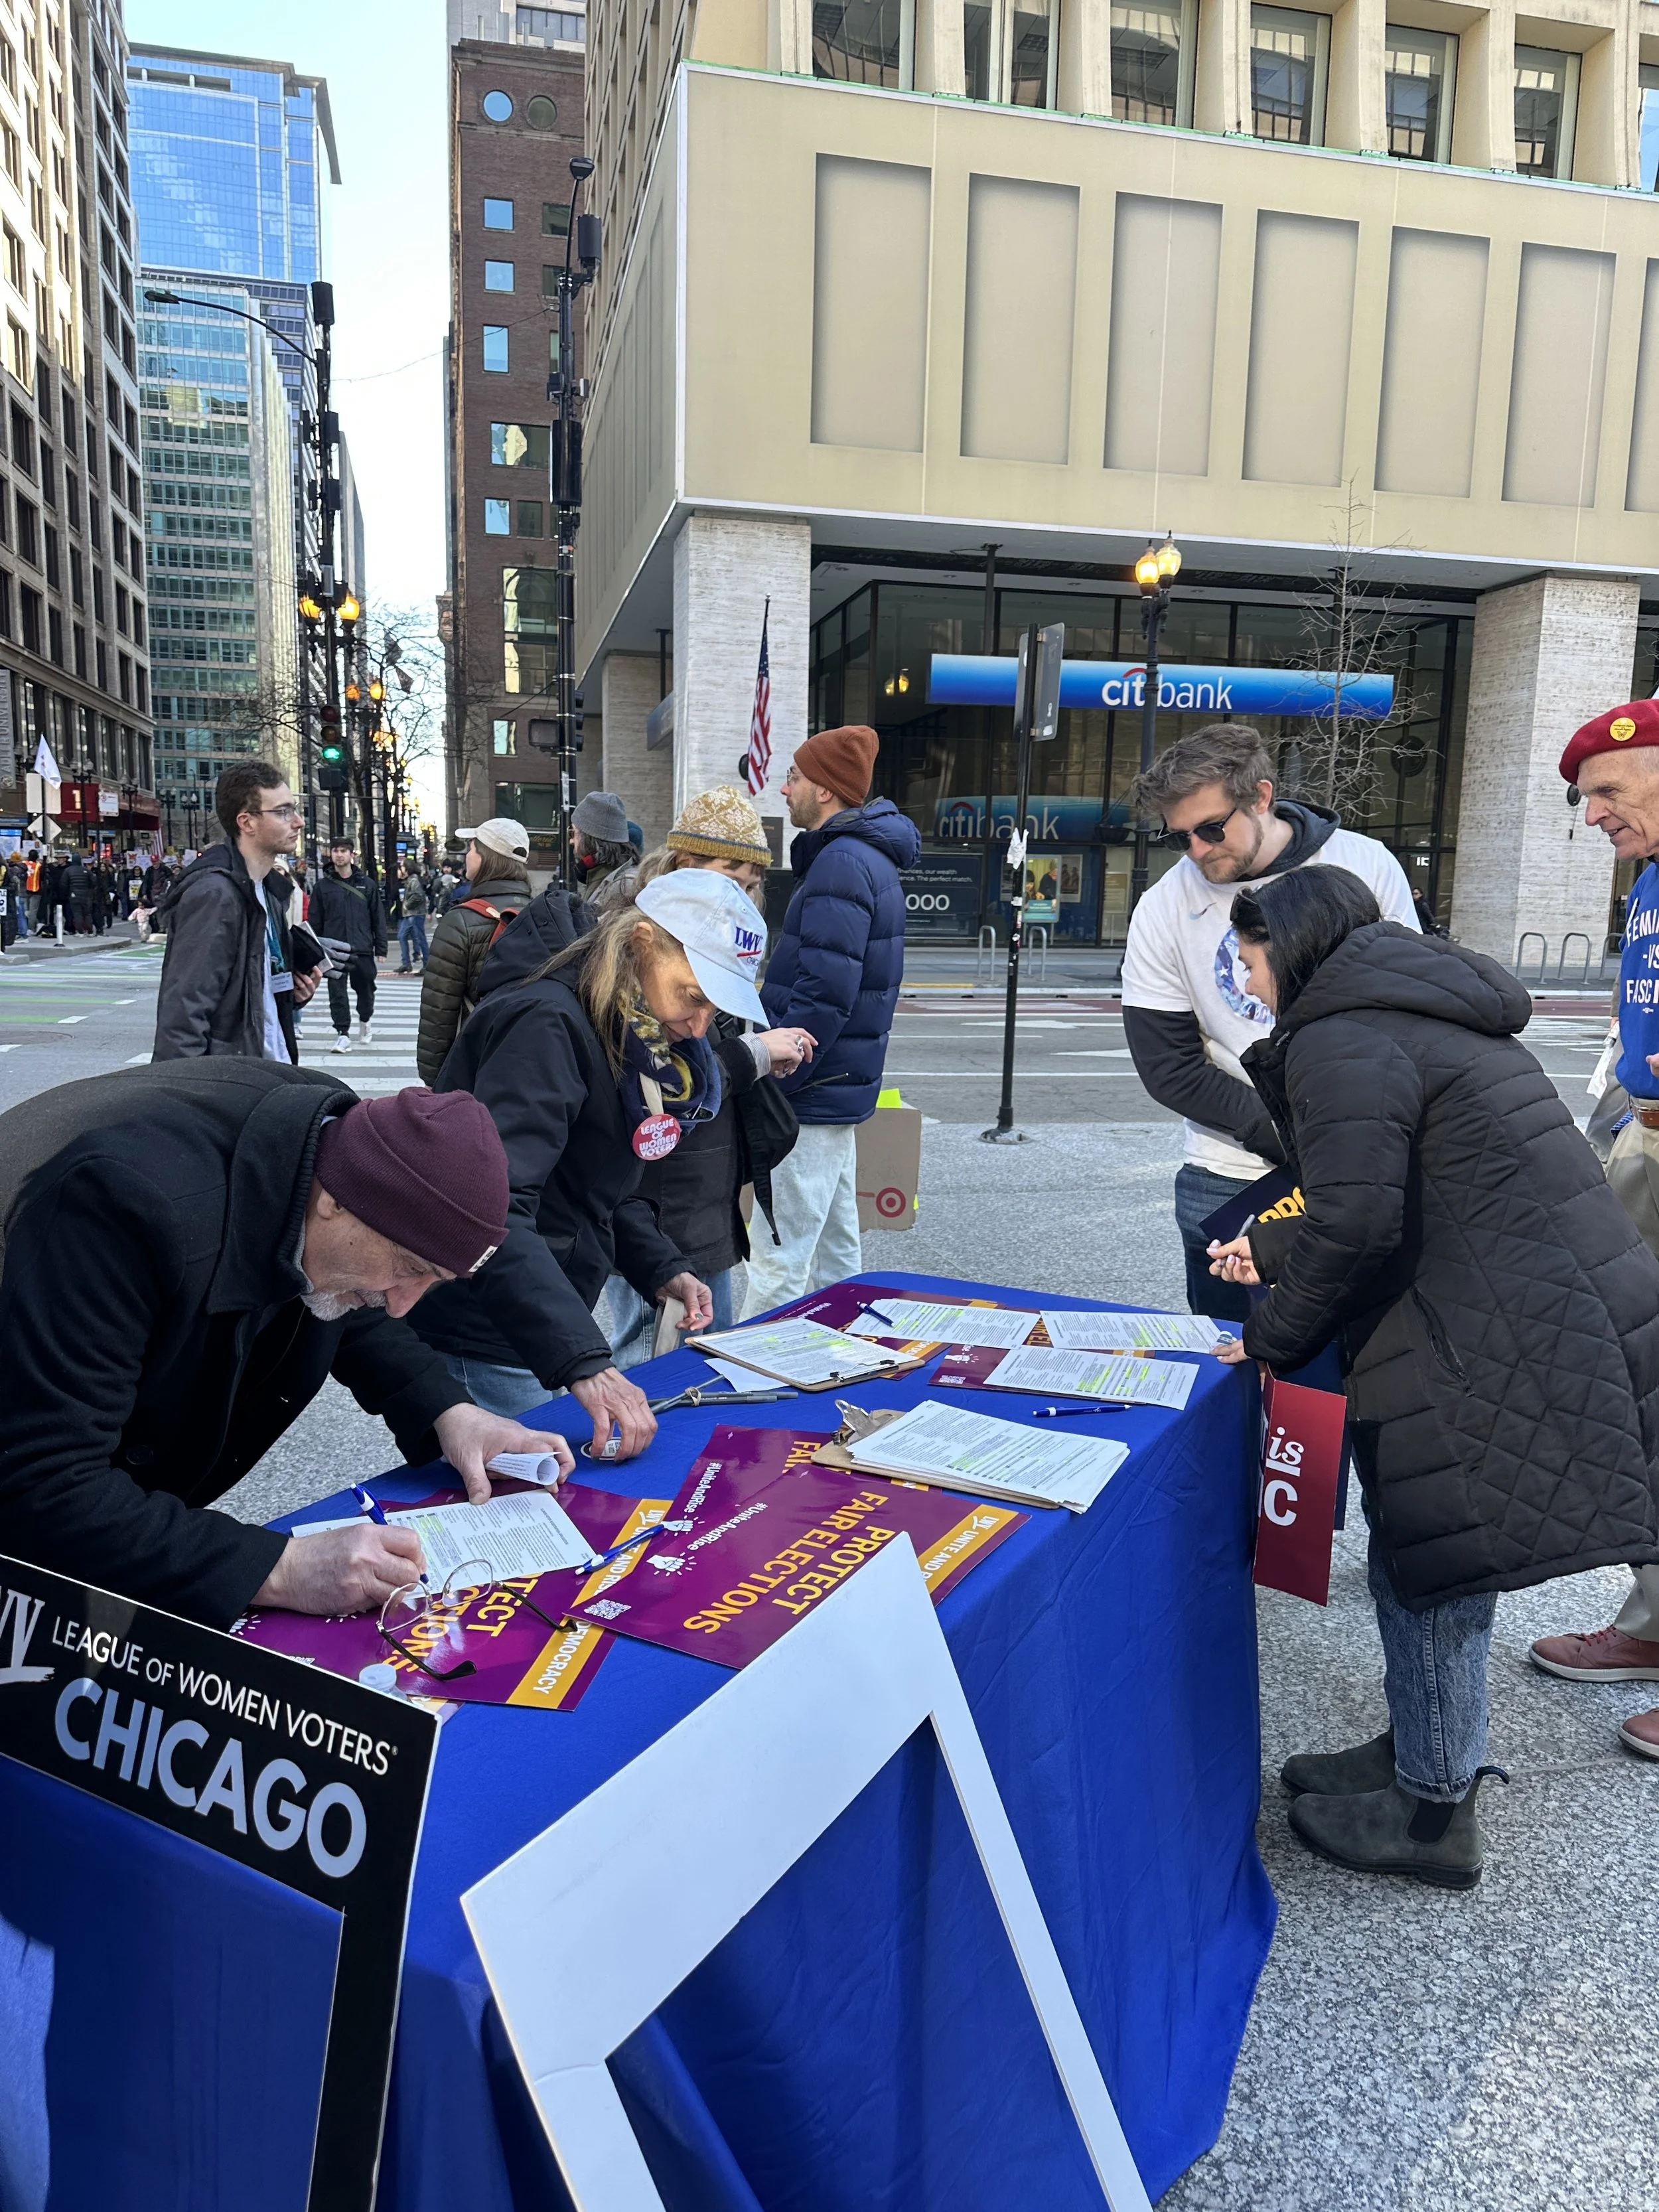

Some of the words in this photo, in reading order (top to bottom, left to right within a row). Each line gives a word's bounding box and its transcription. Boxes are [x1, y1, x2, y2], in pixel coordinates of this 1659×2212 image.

[1102, 673, 1232, 709] citbank
[639, 1133, 677, 1151] WOMEN
[640, 1118, 674, 1135] LEAGUE
[651, 1129, 665, 1140] OF
[640, 1142, 676, 1157] VOTERS
[684, 1462, 723, 1513] #UniteAndRise
[1263, 1479, 1298, 1526] C
[687, 1503, 768, 1550] #UniteAndRise
[821, 1491, 889, 1530] FAIR
[942, 1530, 979, 1554] UNITE
[610, 1554, 634, 1574] AND
[772, 1526, 896, 1615] PROTECT
[924, 1551, 952, 1571] AND
[683, 1528, 841, 1633] ELECTIONS
[53, 1616, 143, 1676] LEAGUE
[146, 1657, 173, 1686] OF
[178, 1662, 280, 1730] WOMEN
[54, 1677, 366, 1878] CHICAGO
